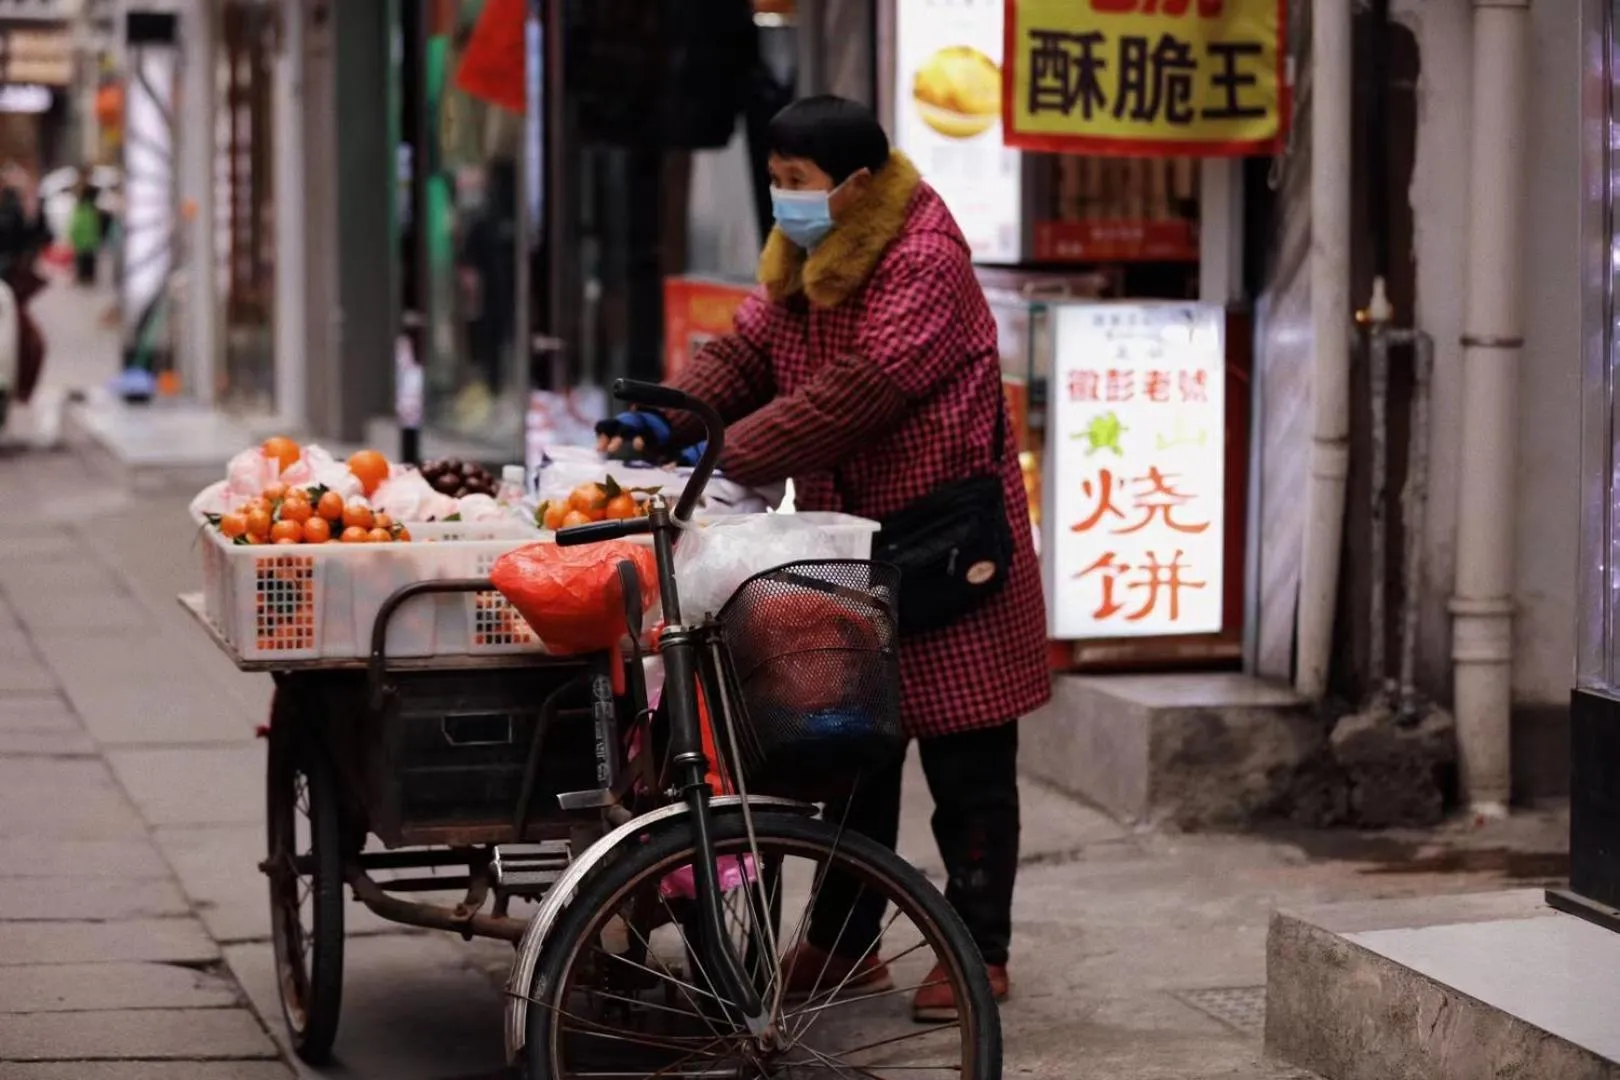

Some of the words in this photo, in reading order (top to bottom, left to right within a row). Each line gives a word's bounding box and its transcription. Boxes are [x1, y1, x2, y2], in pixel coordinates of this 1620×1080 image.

[1027, 28, 1267, 124] 酥脆王
[1069, 466, 1211, 535] 烧
[1070, 549, 1207, 621] 饼
